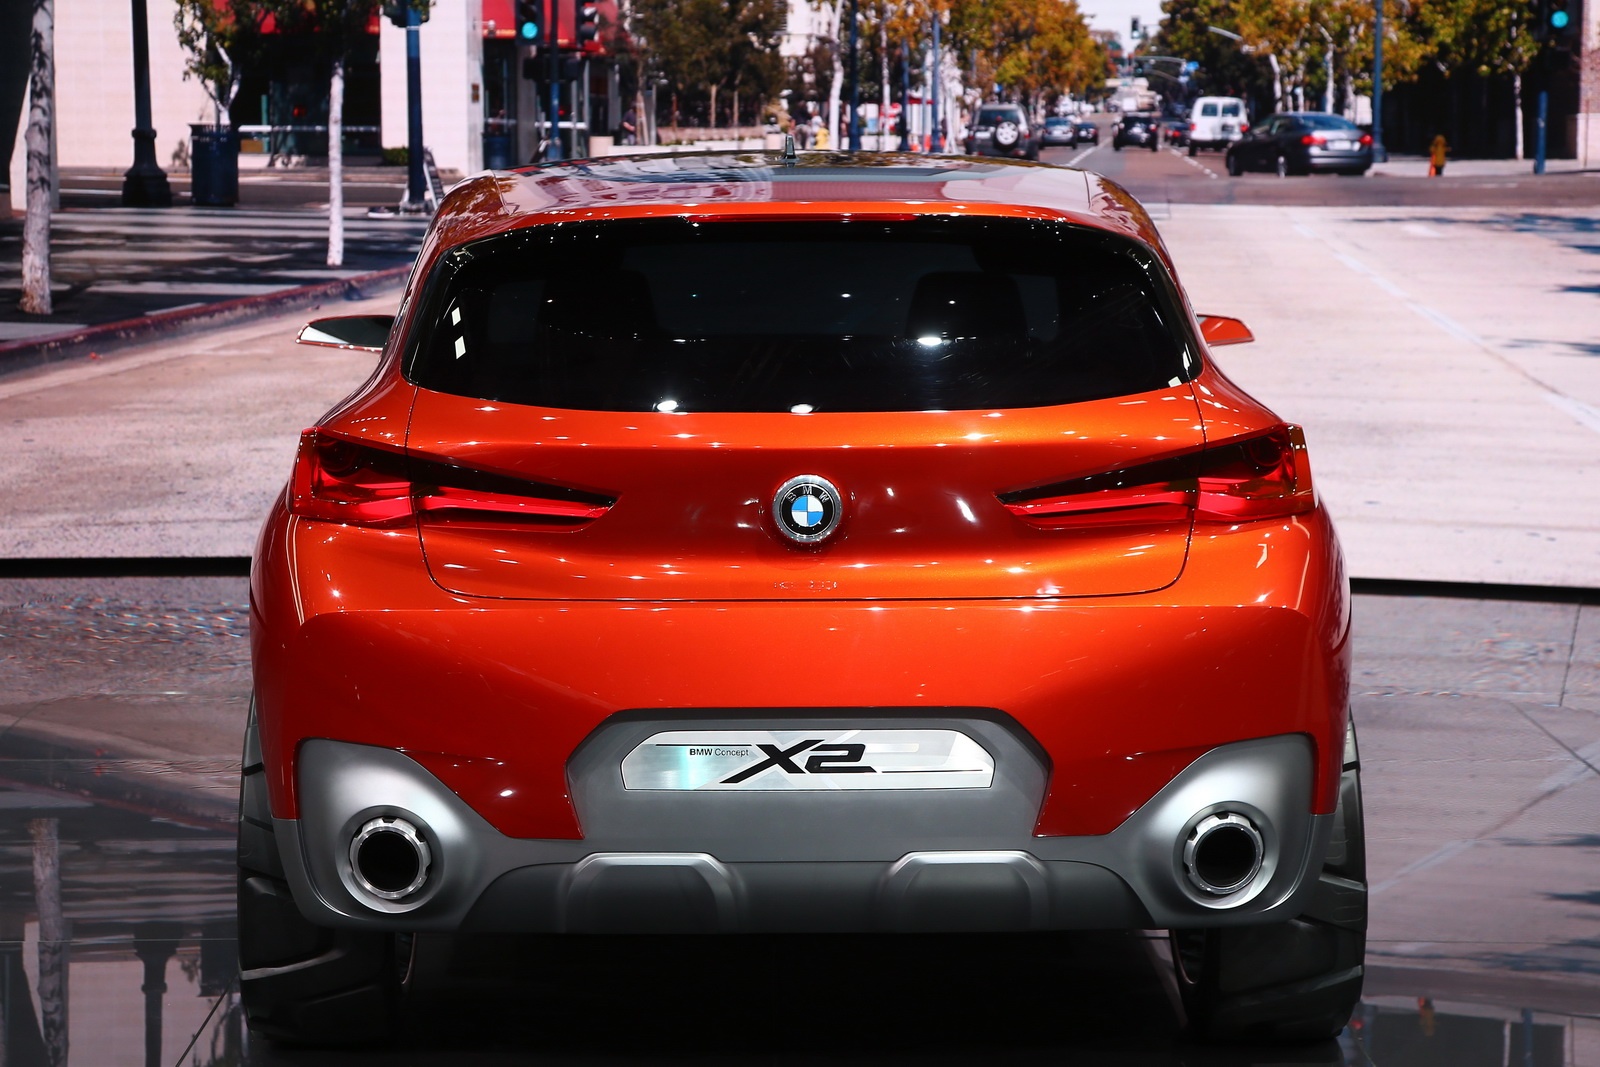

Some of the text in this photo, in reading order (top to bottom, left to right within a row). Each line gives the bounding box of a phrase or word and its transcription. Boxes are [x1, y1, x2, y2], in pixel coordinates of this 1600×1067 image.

[786, 486, 830, 503] BMW
[689, 748, 749, 757] BMW Concept
[719, 739, 877, 783] X2
